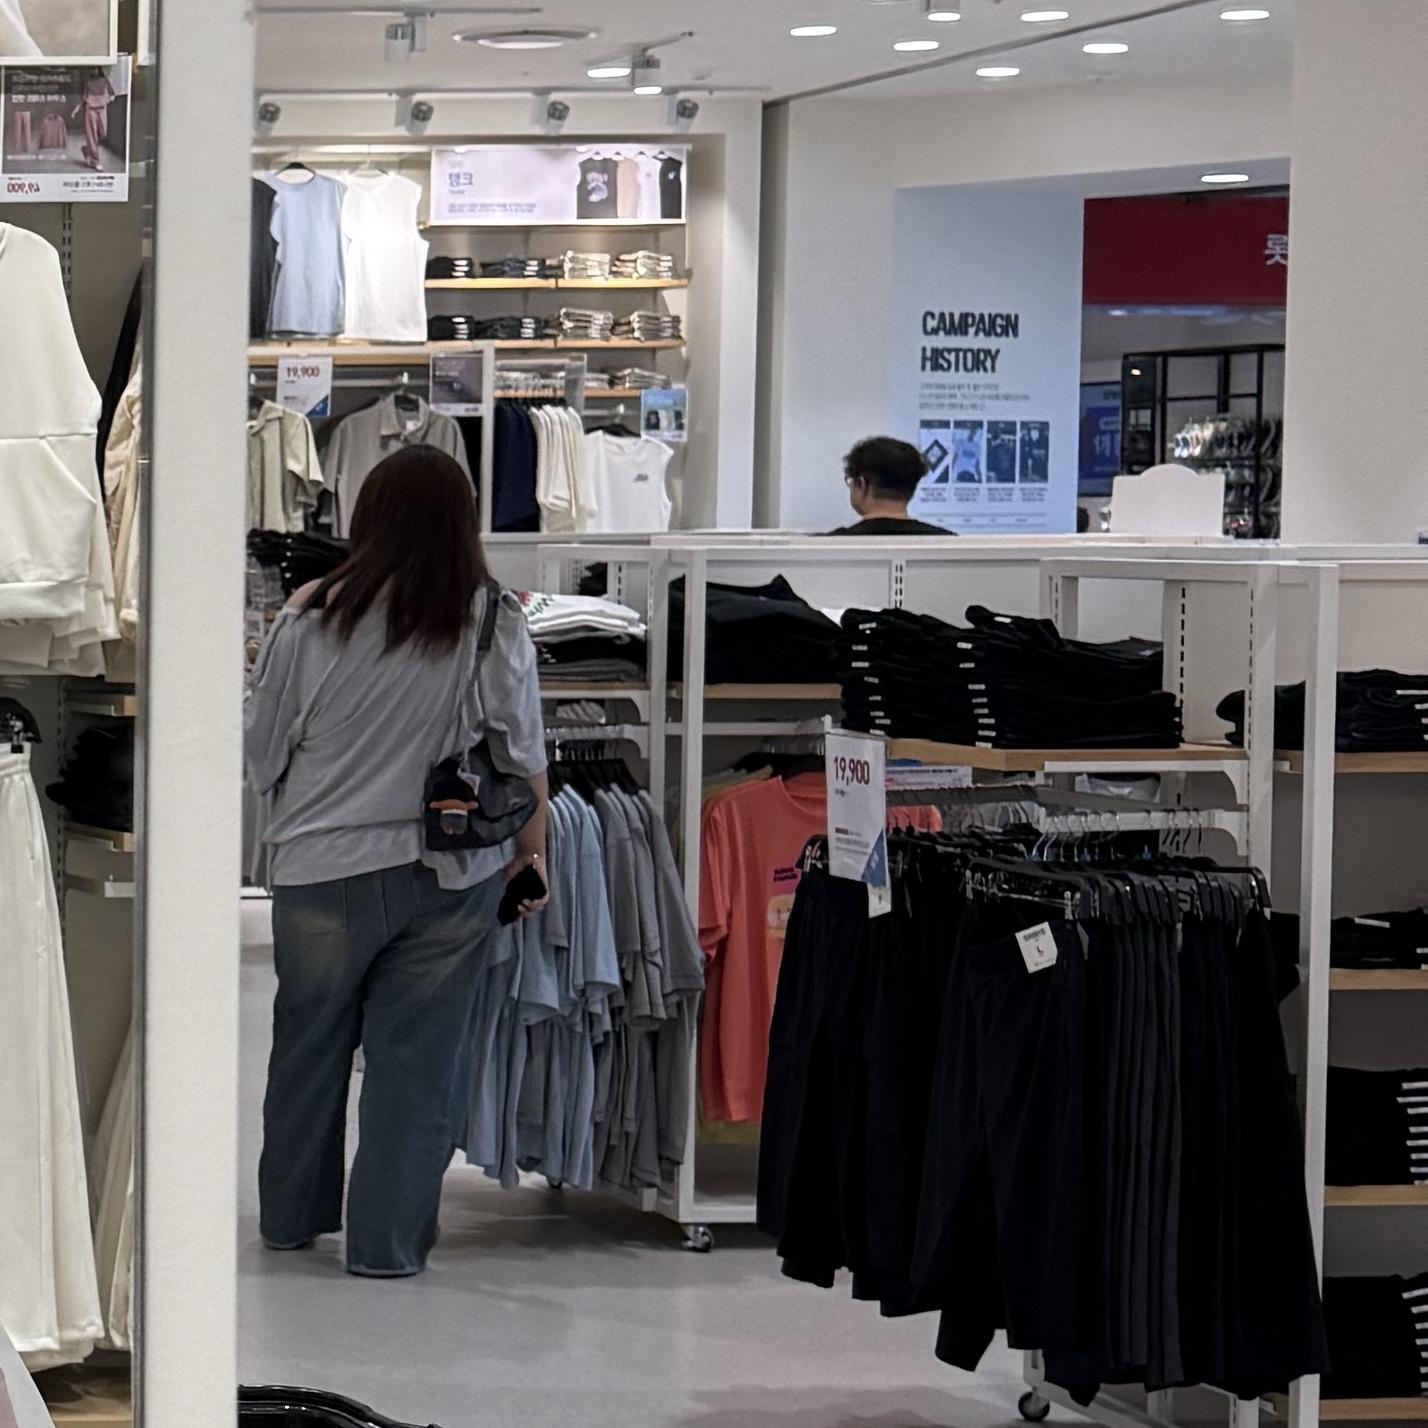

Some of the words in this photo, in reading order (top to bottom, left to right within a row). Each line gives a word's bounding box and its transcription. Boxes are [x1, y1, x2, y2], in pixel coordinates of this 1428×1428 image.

[921, 310, 1020, 339] CAMPAIGN
[920, 346, 1001, 374] HISTORY
[833, 755, 871, 786] 19,900
